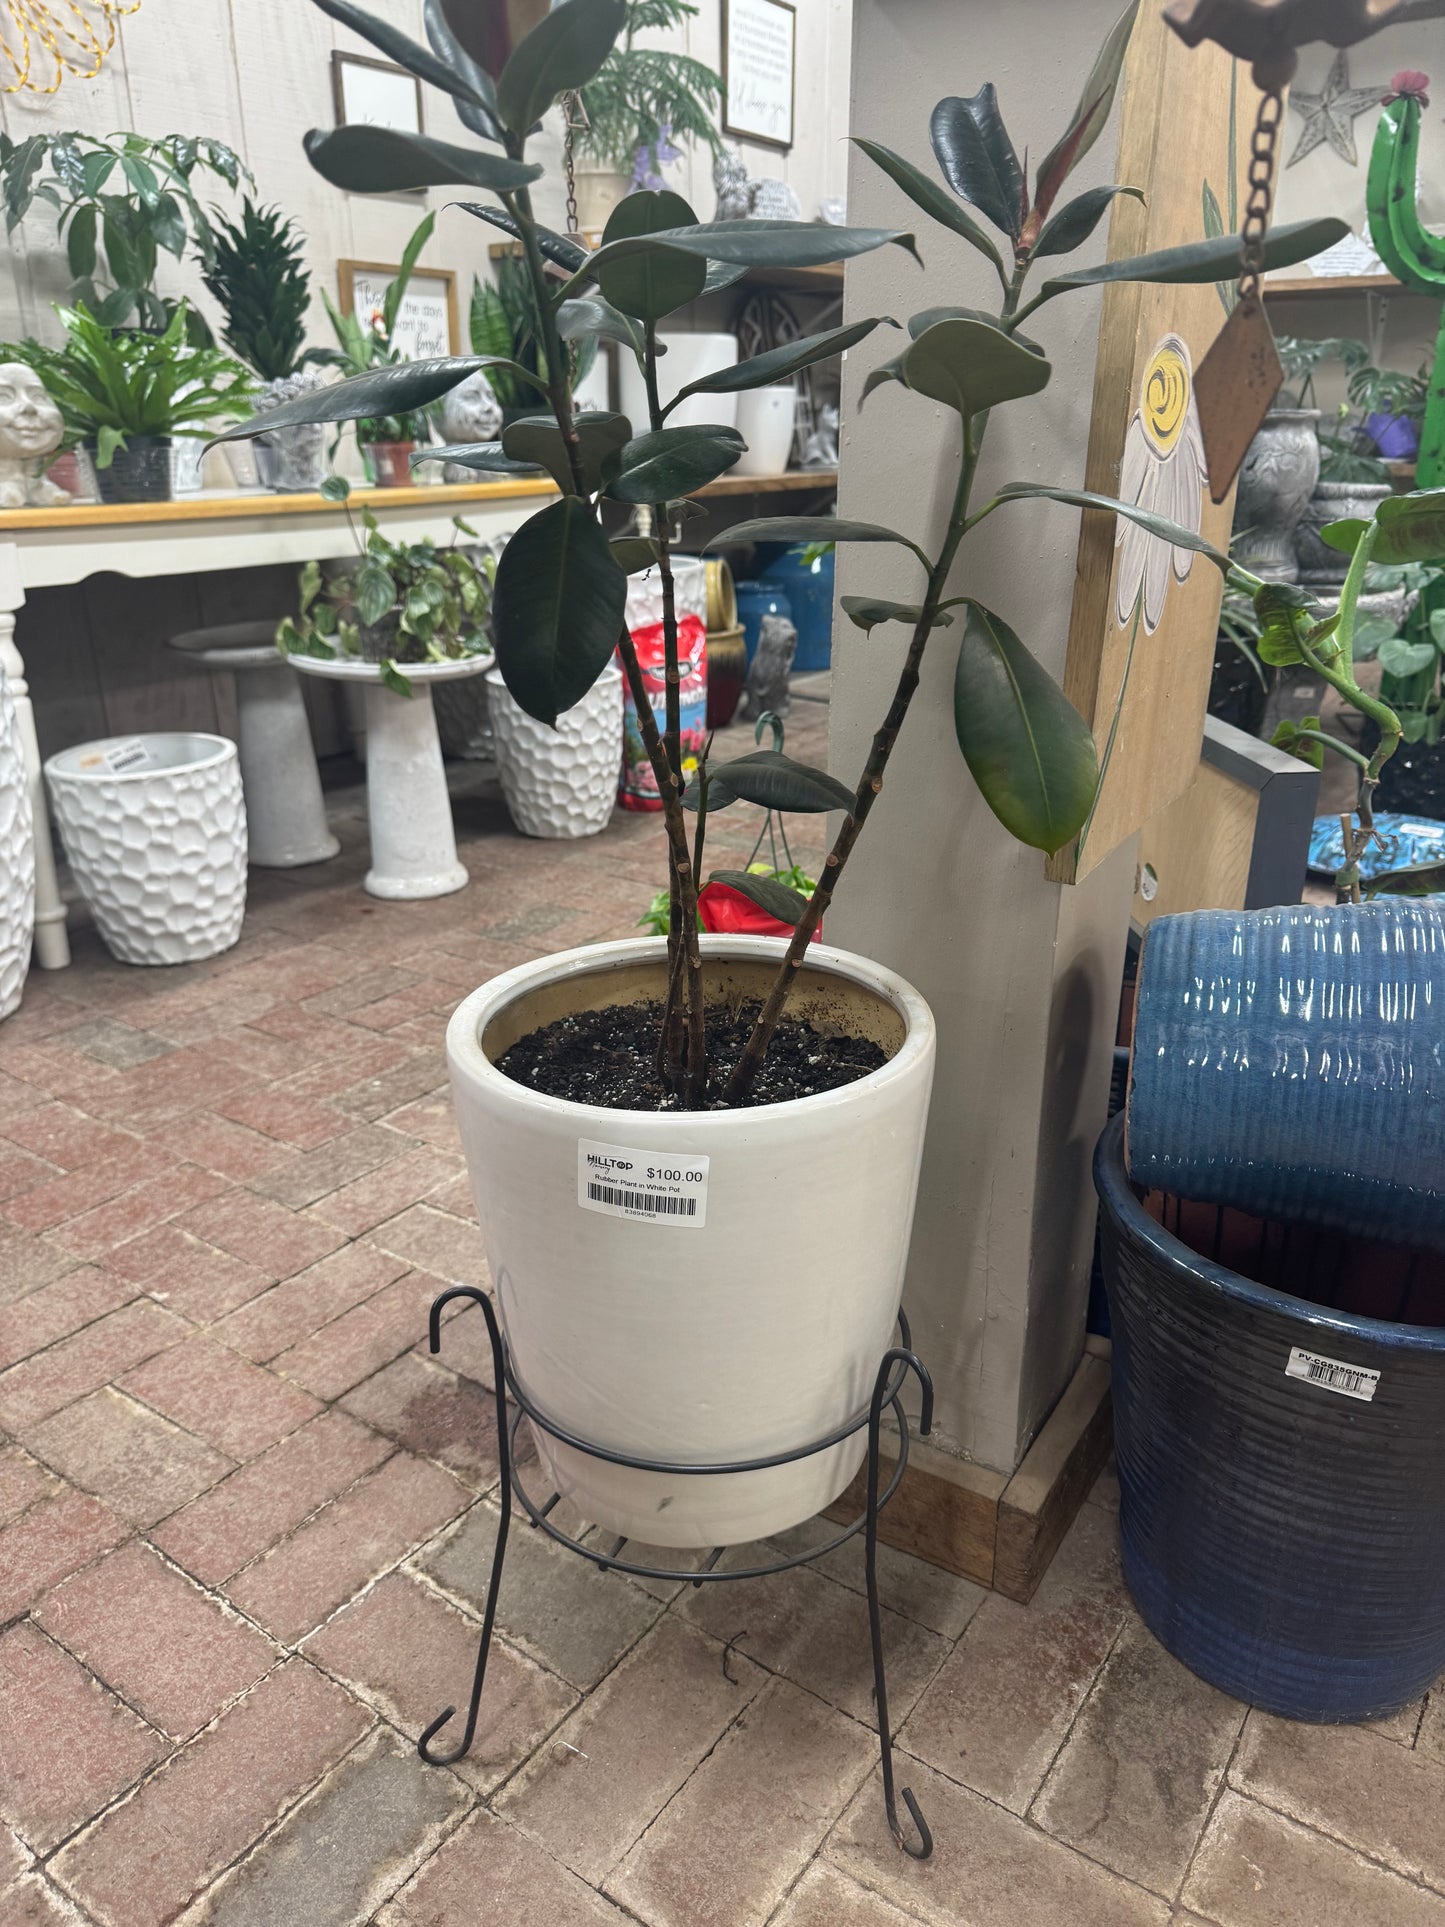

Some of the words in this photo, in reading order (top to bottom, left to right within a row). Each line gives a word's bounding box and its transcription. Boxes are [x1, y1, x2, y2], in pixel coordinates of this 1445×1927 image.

[587, 1153, 634, 1171] HILLTOP
[646, 1167, 703, 1183] $100.00
[594, 1173, 619, 1184] Rubber
[620, 1179, 638, 1188] Plant
[646, 1183, 667, 1192] White
